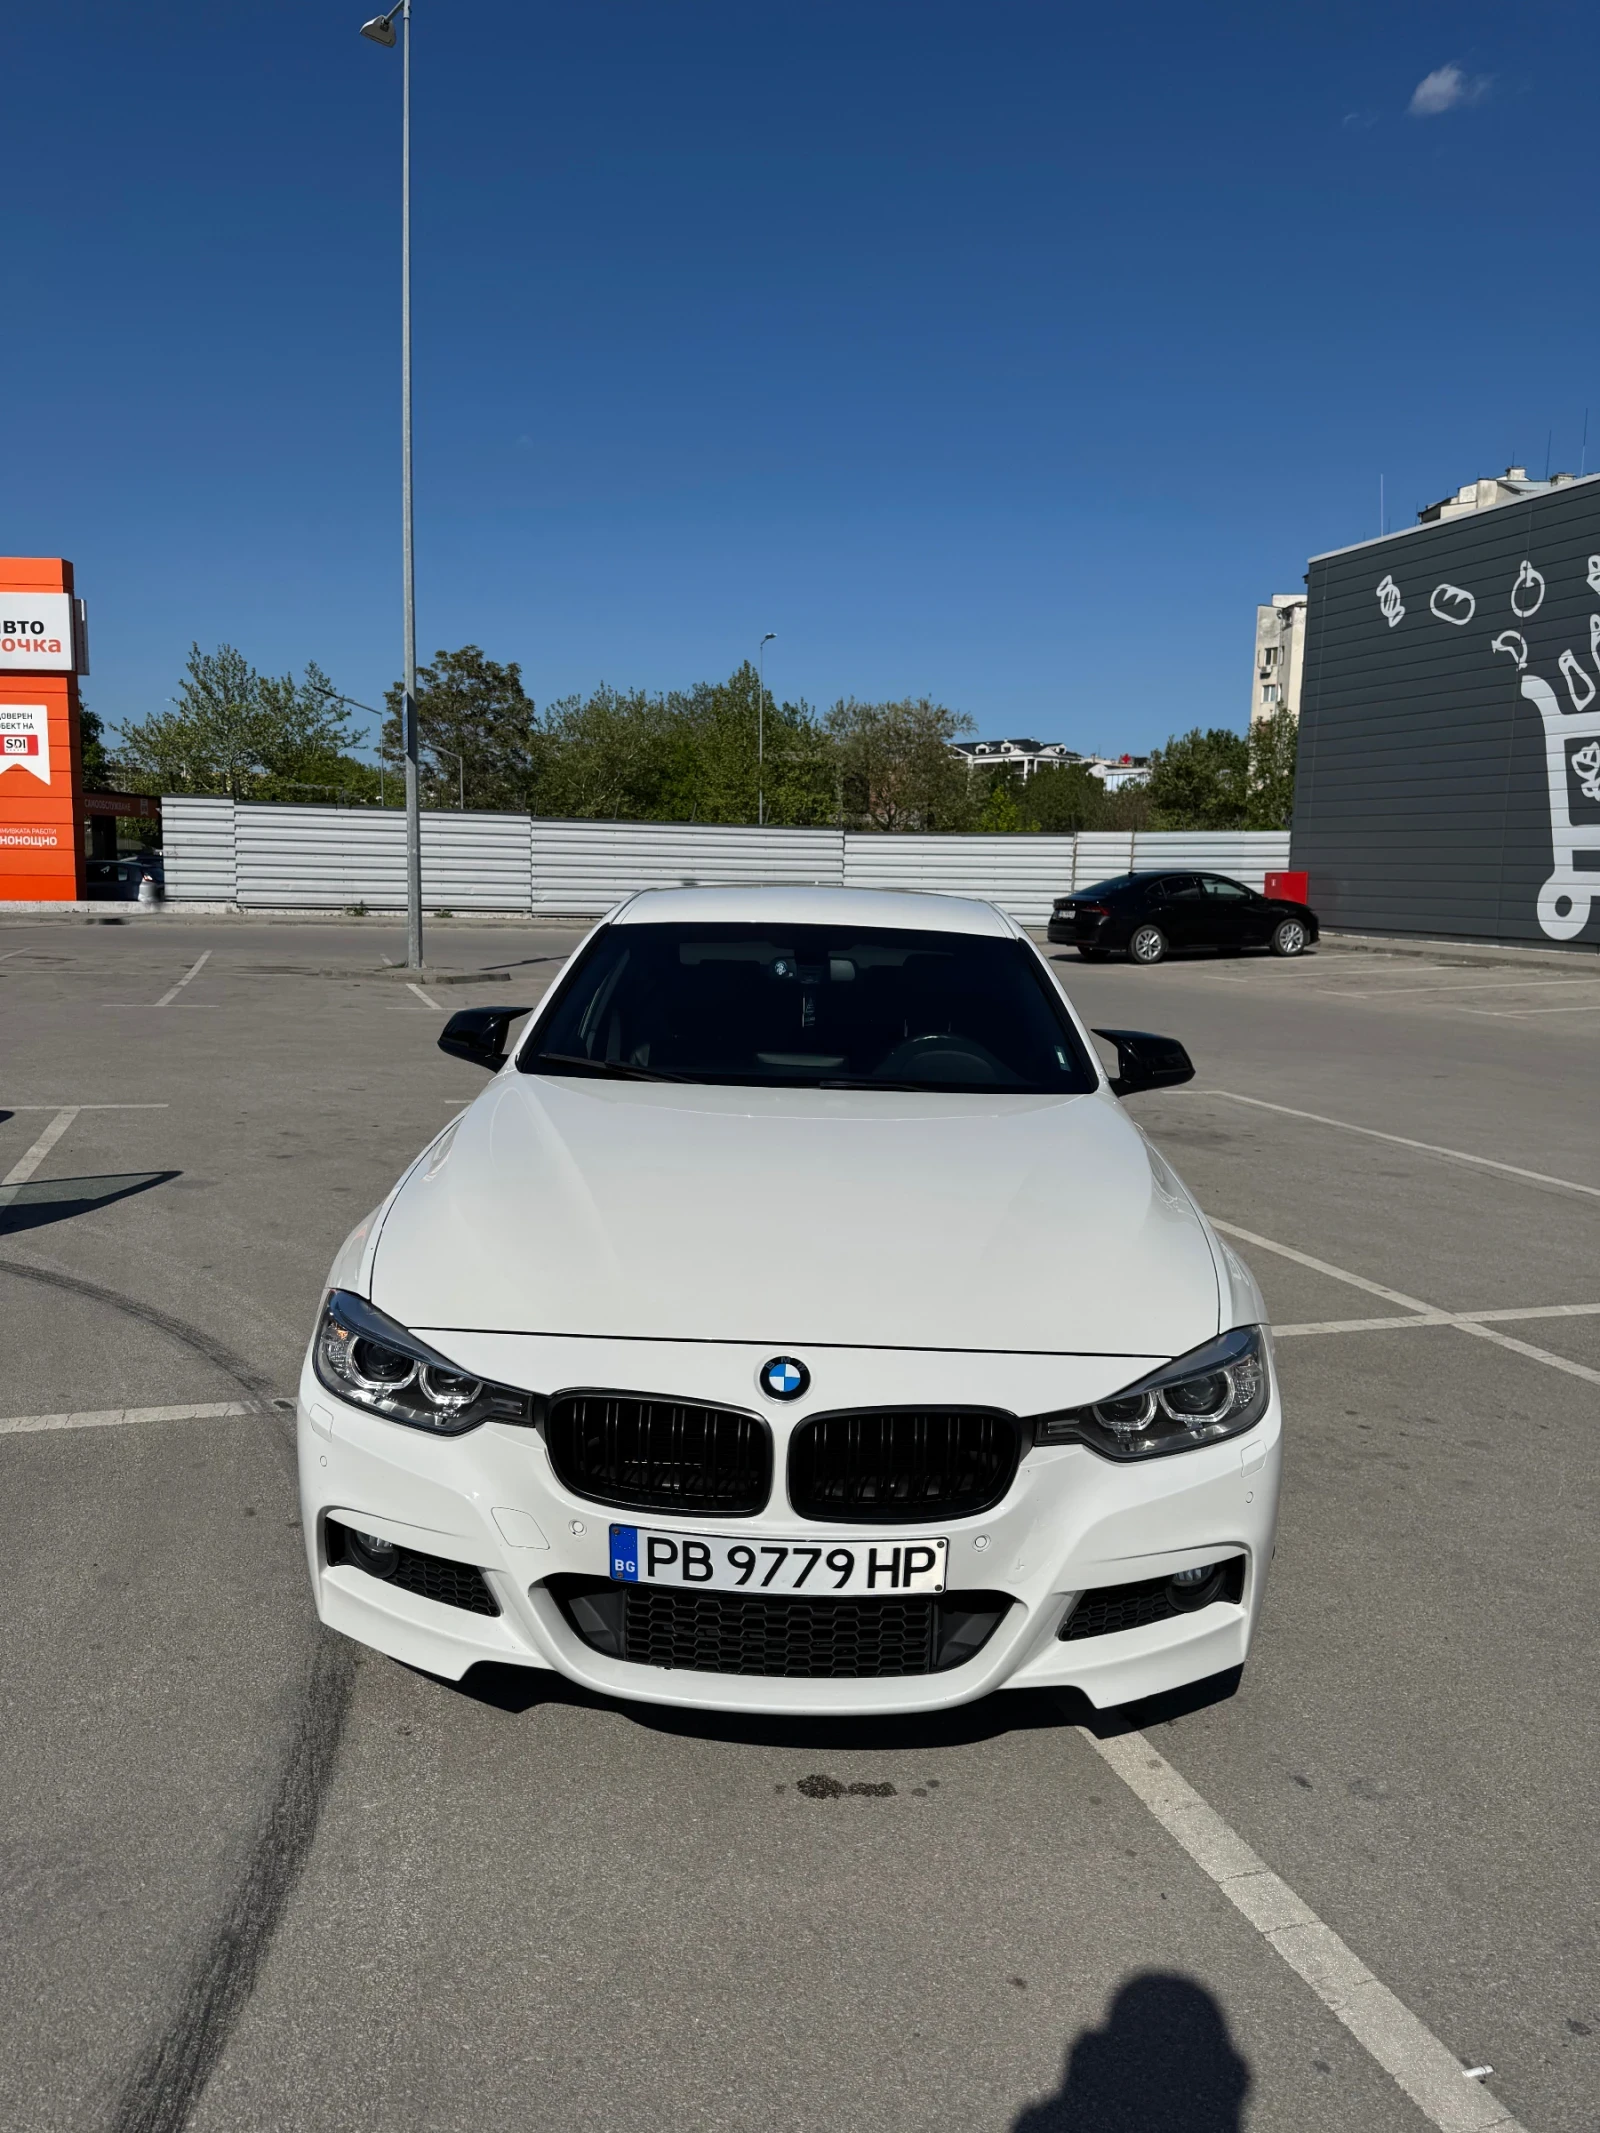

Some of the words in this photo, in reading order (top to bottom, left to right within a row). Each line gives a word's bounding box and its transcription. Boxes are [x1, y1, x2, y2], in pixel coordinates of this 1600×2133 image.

[0, 620, 45, 635] вто
[0, 637, 62, 653] очка
[0, 712, 33, 720] ОВЕРЕН
[0, 722, 21, 730] БЕКТ
[22, 722, 35, 730] НА
[6, 738, 26, 749] SDI
[0, 827, 31, 835] МИВКАТА
[32, 828, 57, 836] РАБОТИ
[614, 1559, 636, 1573] BG
[646, 1536, 714, 1582] PB
[727, 1545, 855, 1589] 9779
[867, 1546, 936, 1589] HP
